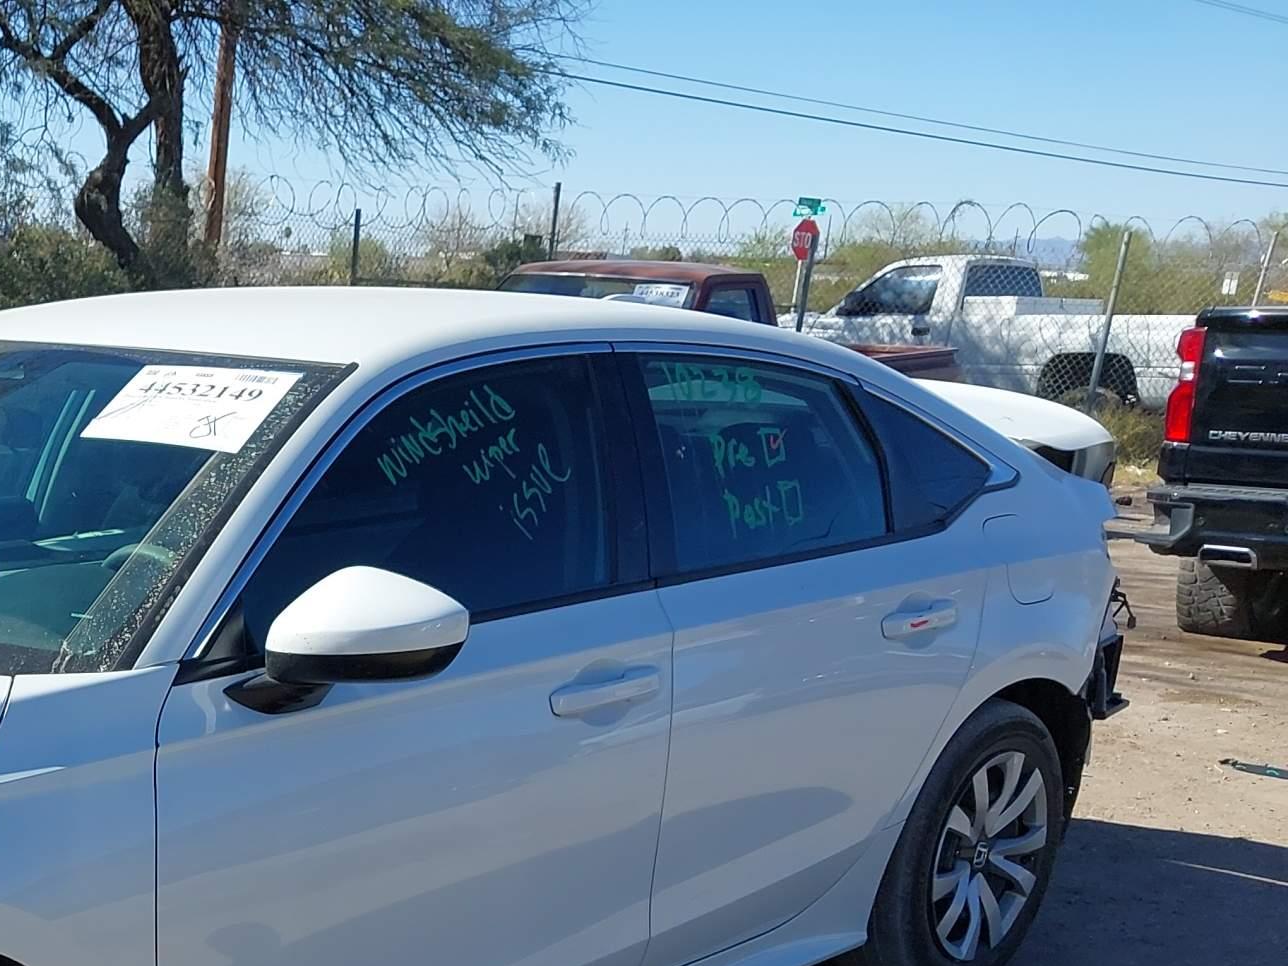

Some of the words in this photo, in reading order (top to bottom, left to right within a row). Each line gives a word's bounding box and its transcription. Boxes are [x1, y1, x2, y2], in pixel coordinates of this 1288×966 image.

[793, 231, 813, 249] STO
[139, 381, 264, 401] 44532149
[1208, 430, 1288, 443] CHEYENNE
